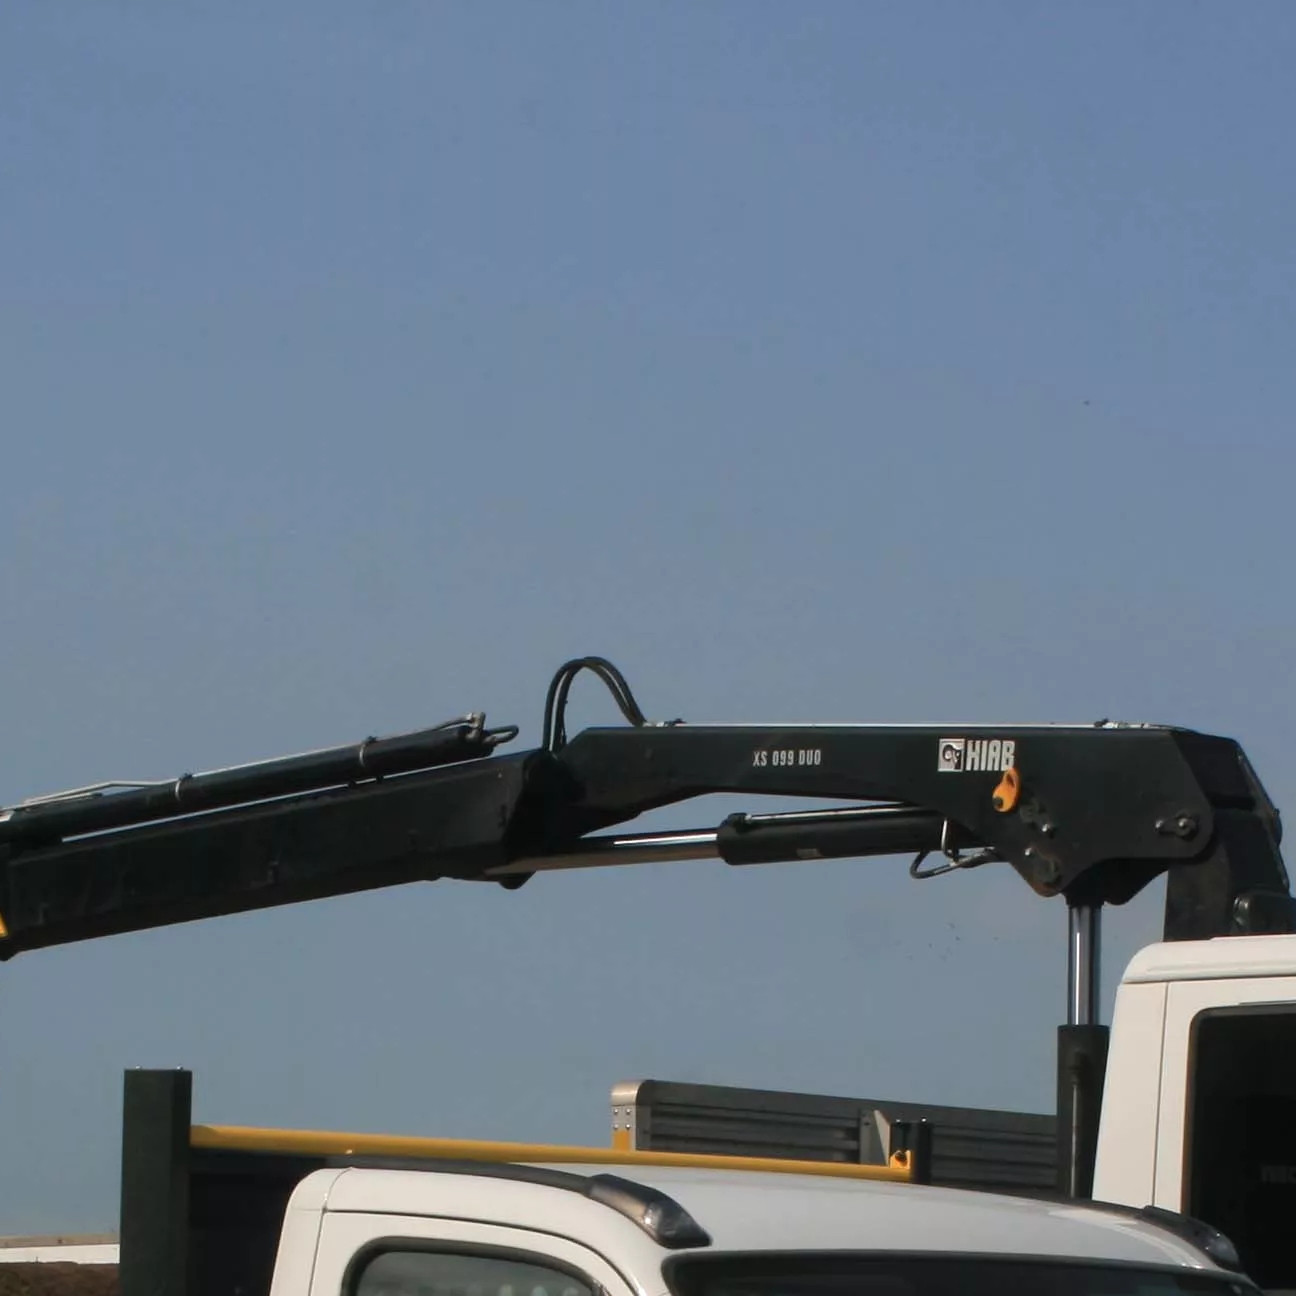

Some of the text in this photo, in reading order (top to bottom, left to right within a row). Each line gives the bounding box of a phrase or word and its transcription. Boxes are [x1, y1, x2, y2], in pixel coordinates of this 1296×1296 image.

[752, 749, 822, 767] XS 099 DUO
[965, 740, 1015, 771] HIAB
